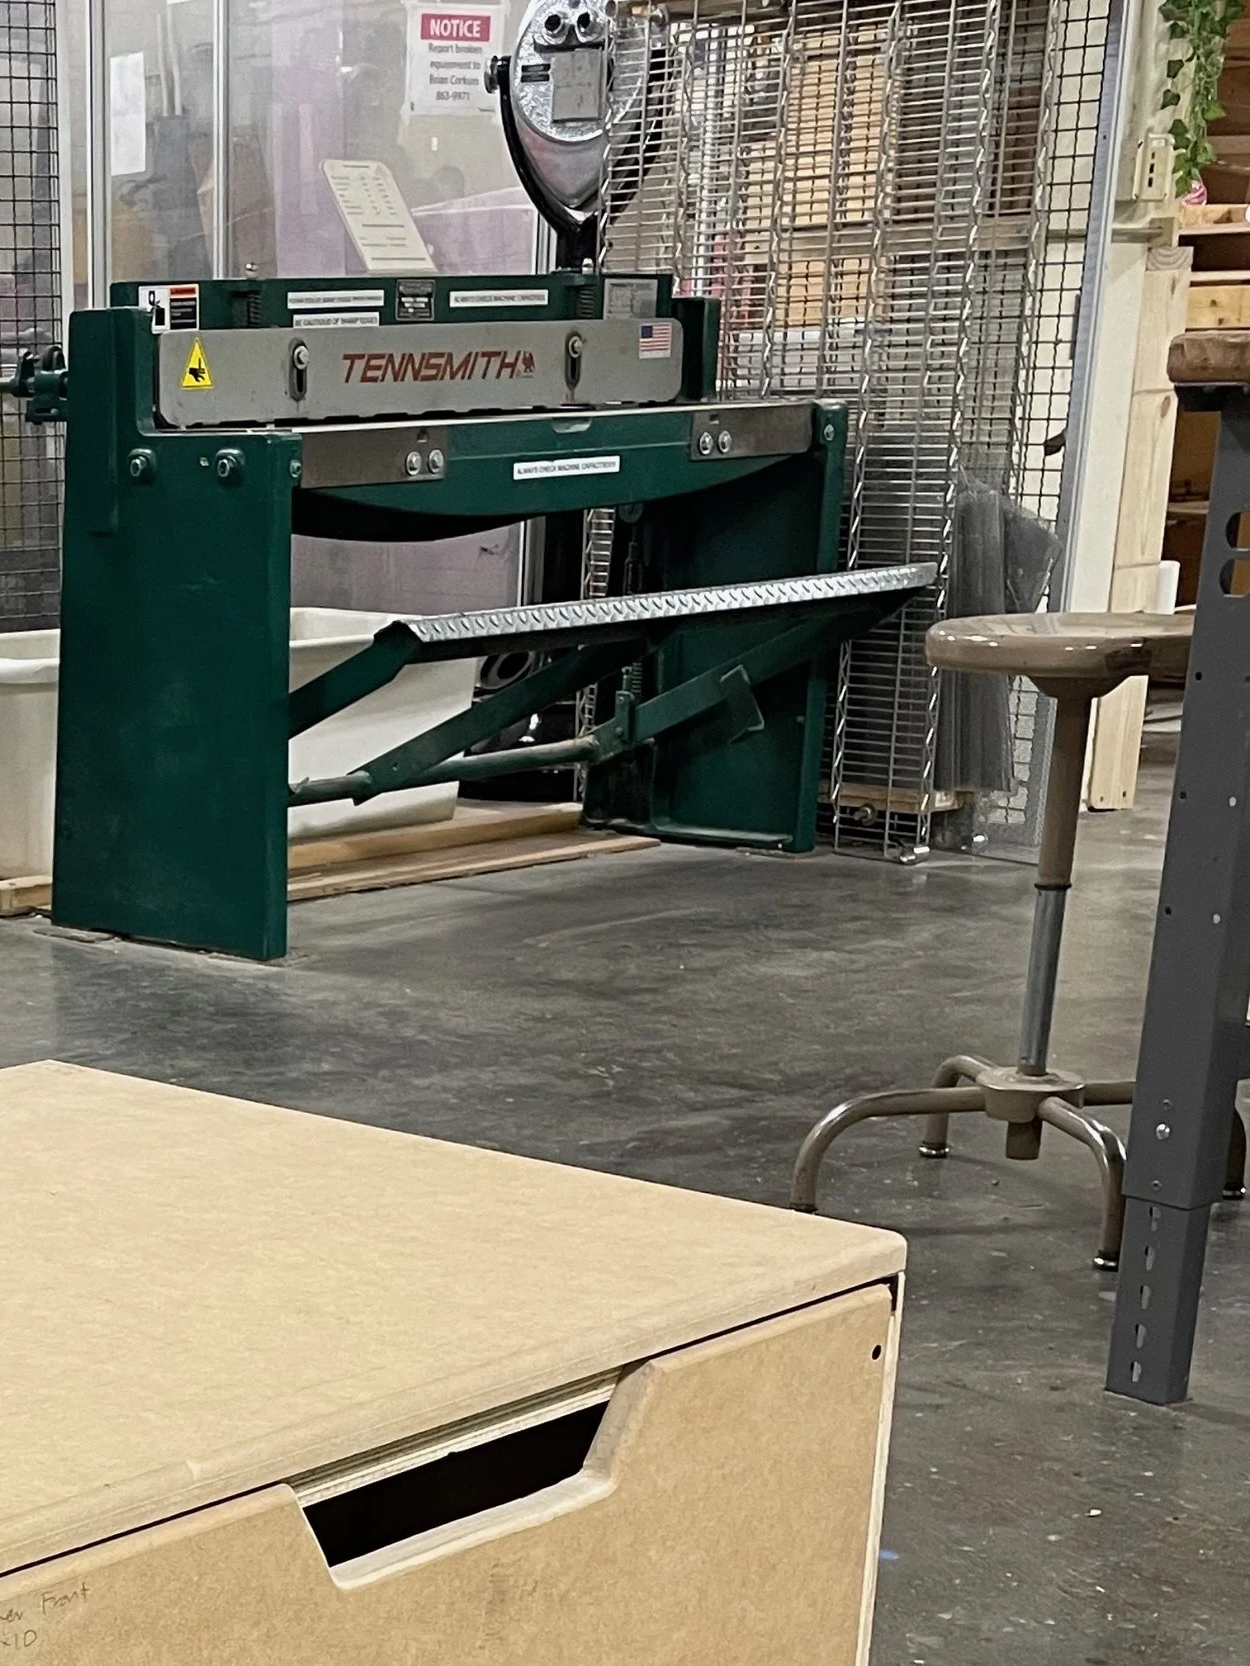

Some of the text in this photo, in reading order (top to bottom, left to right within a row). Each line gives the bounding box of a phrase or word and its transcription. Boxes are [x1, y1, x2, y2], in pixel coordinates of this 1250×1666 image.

[430, 18, 482, 38] NOTICE
[428, 43, 483, 54] Report broken
[430, 61, 481, 70] equipment to
[342, 350, 521, 384] TENNSMITH
[41, 1582, 92, 1616] Front
